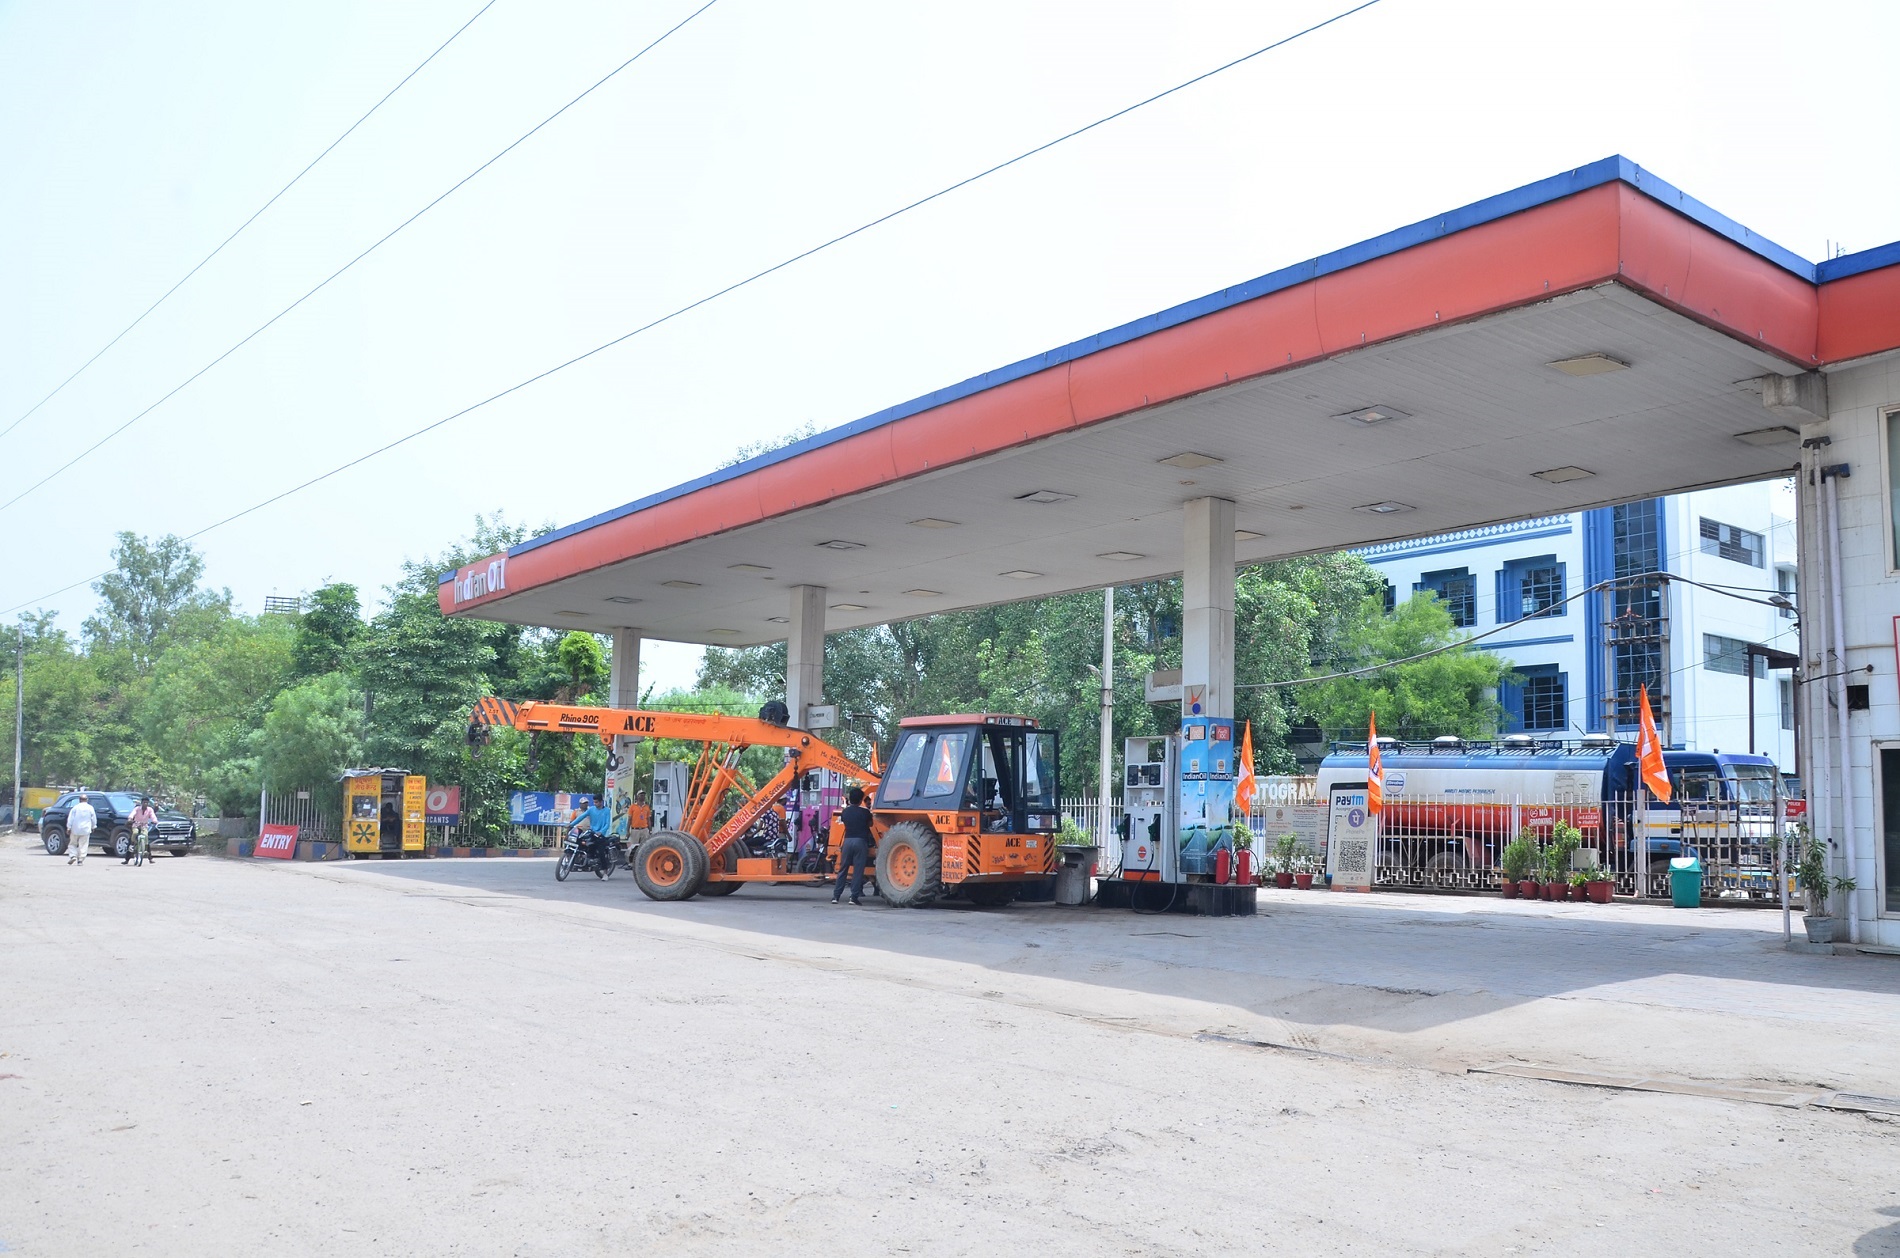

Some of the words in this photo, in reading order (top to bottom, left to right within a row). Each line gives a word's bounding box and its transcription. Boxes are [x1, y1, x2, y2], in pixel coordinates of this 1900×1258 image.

[454, 558, 506, 604] IndianOil
[560, 713, 581, 722] Rhino
[583, 714, 599, 724] 90C
[623, 715, 656, 732] ACE
[1539, 809, 1549, 817] NO
[710, 828, 733, 853] AMAR
[732, 809, 752, 834] SINGH
[750, 794, 771, 815] CRANE
[935, 815, 951, 825] ACE
[1530, 818, 1552, 826] SMOKING
[260, 833, 293, 850] ENTRY
[1005, 838, 1021, 847] ACE
[943, 861, 963, 869] CRANE
[942, 872, 963, 880] SERVICE
